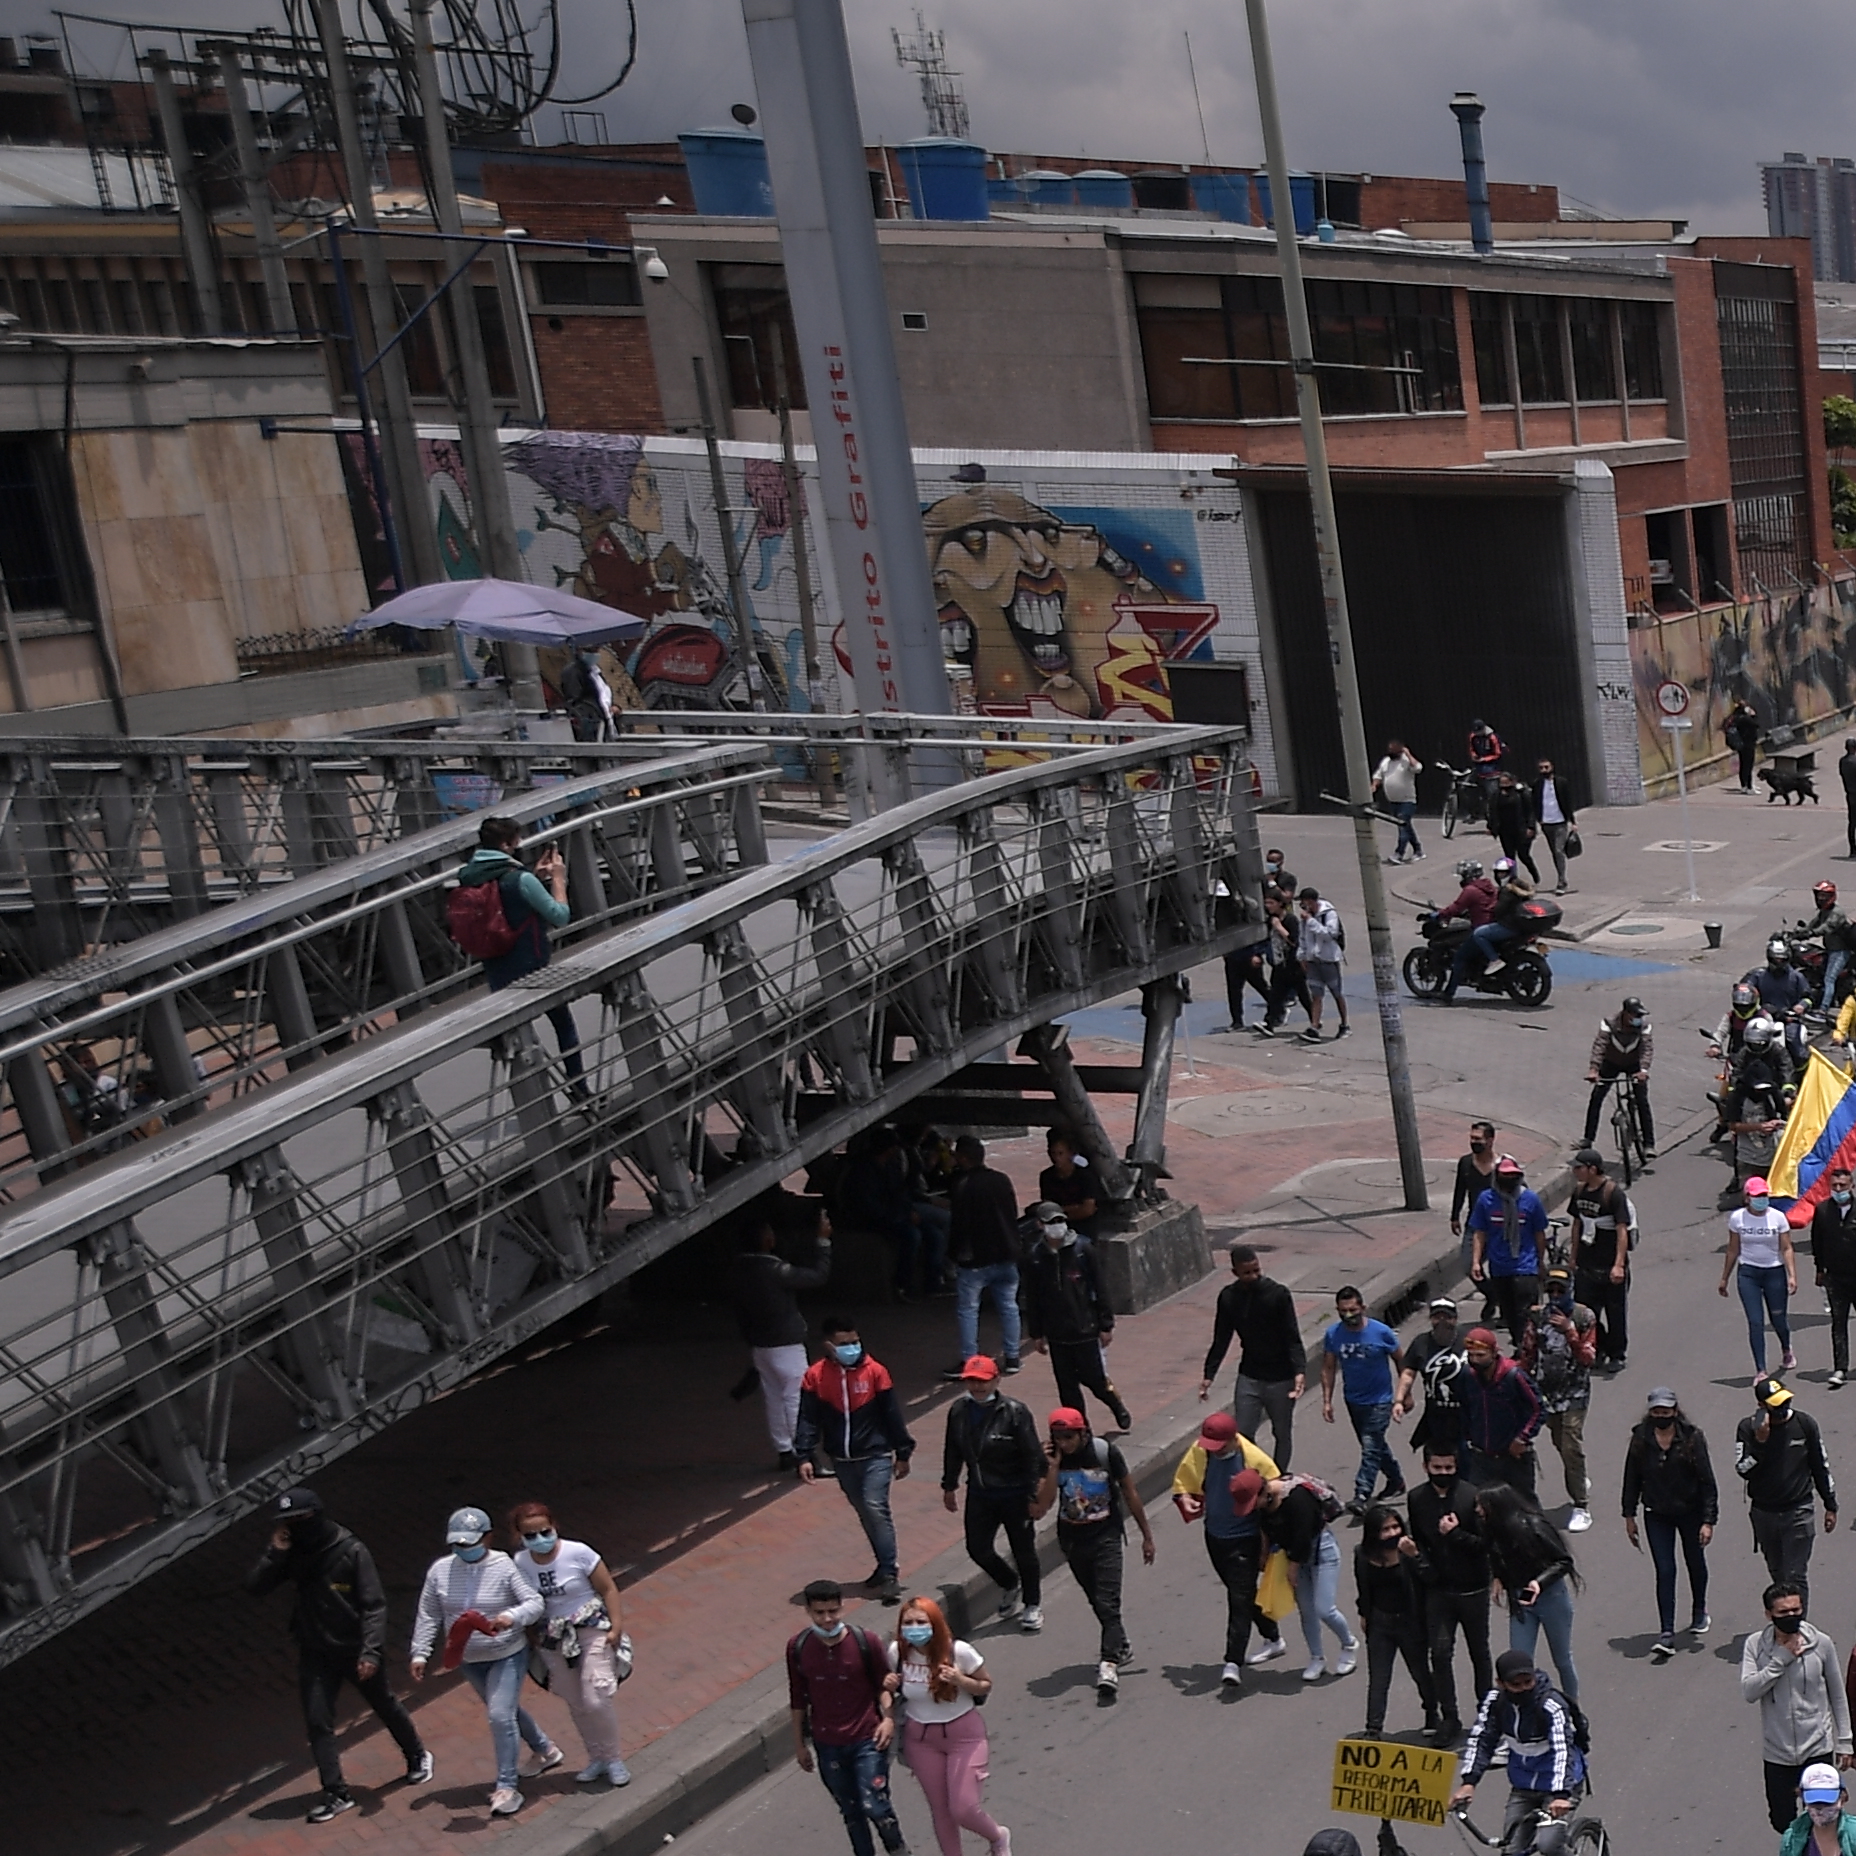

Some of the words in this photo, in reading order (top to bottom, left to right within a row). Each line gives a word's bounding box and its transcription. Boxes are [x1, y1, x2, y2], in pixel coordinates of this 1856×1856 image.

[823, 344, 870, 532] Grafiti
[537, 1570, 558, 1588] BE
[1341, 1745, 1381, 1769] NO
[1389, 1749, 1409, 1771] A
[1421, 1753, 1443, 1774] LA
[1343, 1769, 1421, 1795] REFORMA
[1332, 1785, 1446, 1824] TRIBUTARIA
